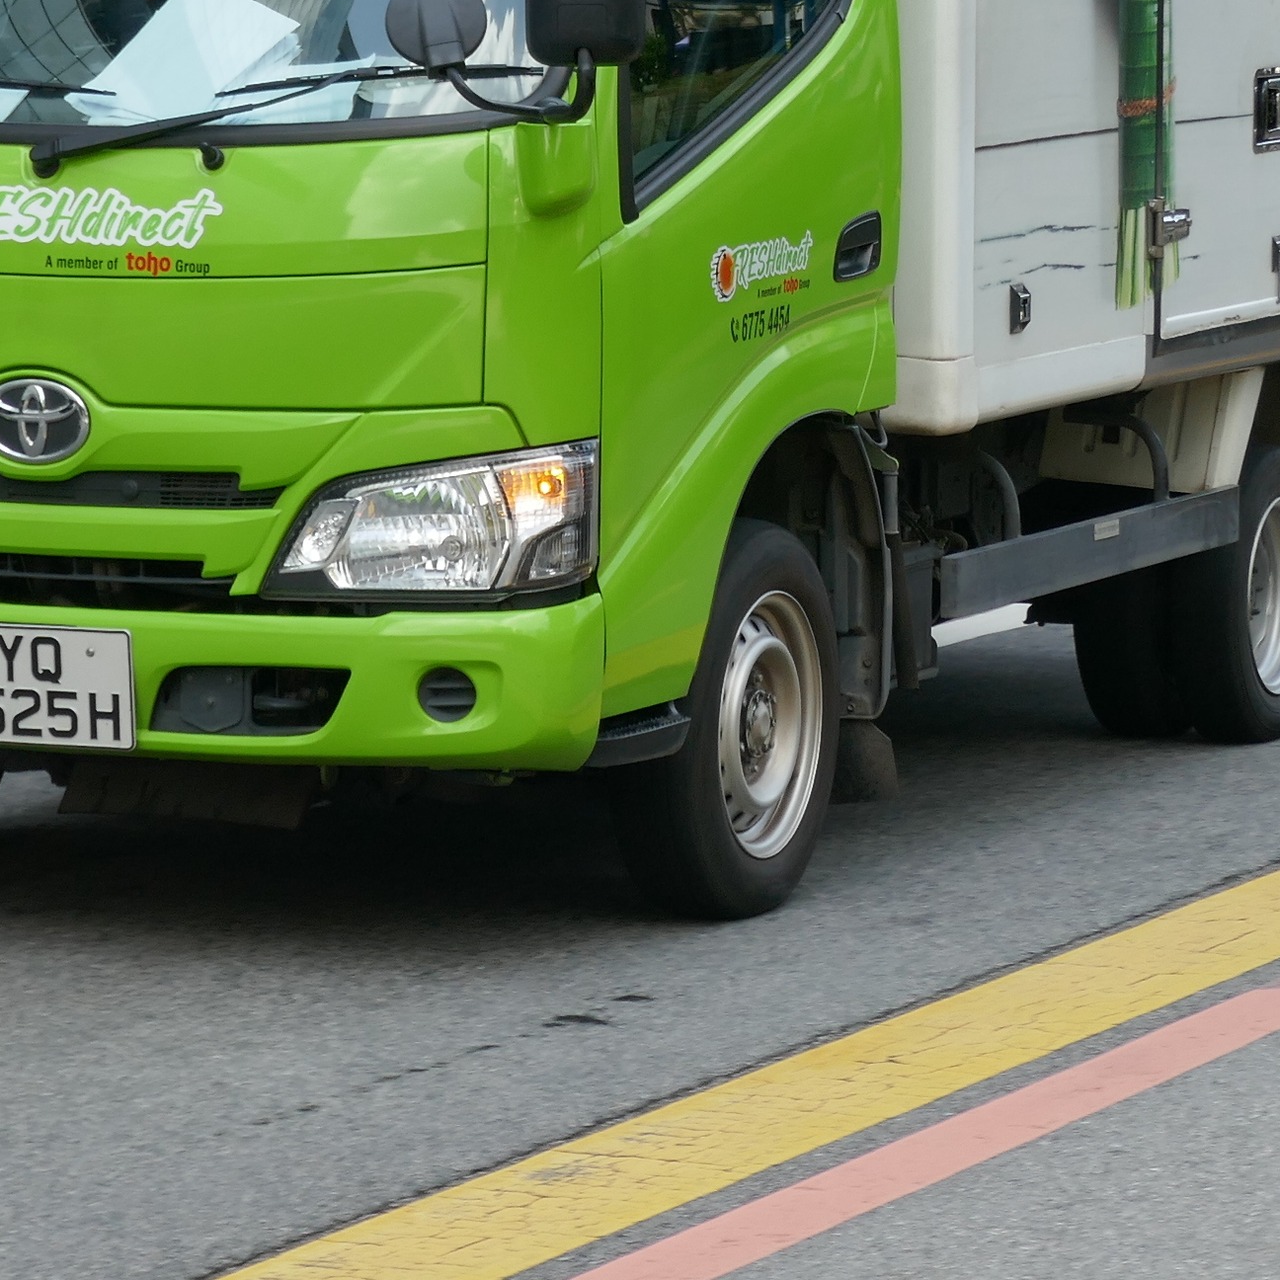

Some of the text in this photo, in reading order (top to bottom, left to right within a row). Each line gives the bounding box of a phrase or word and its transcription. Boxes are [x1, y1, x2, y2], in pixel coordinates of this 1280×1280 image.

[45, 252, 211, 277] A member of toho Group
[731, 233, 812, 287] FRESHdirect
[741, 304, 790, 342] 6775 4454
